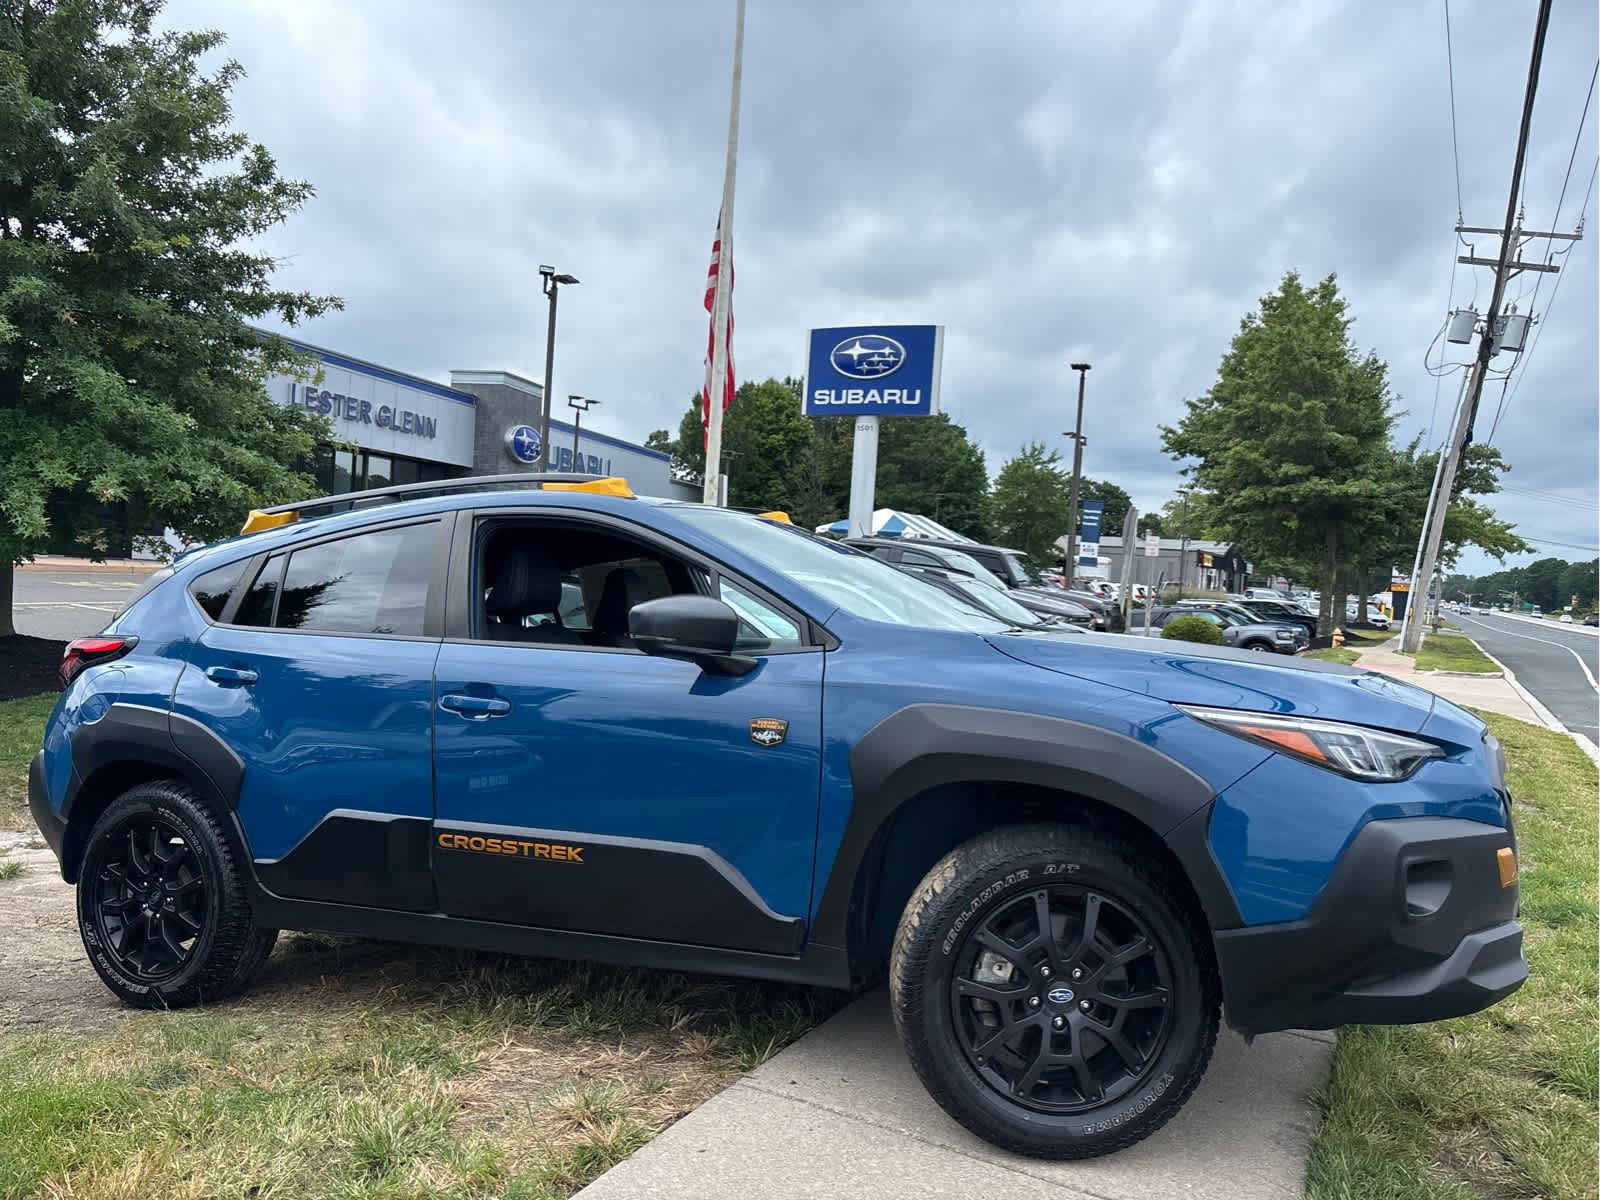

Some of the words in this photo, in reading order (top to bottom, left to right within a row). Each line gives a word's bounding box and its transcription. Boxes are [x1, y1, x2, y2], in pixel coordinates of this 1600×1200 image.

[288, 383, 373, 425] LESTER
[375, 404, 437, 439] GLENN
[814, 388, 921, 405] SUBARU
[547, 444, 611, 477] UBARU
[438, 833, 585, 862] CROSSTREK
[942, 869, 1031, 956] GEOLANDAR
[1043, 863, 1080, 875] A/T
[1082, 1073, 1175, 1135] YOKOHAMA
